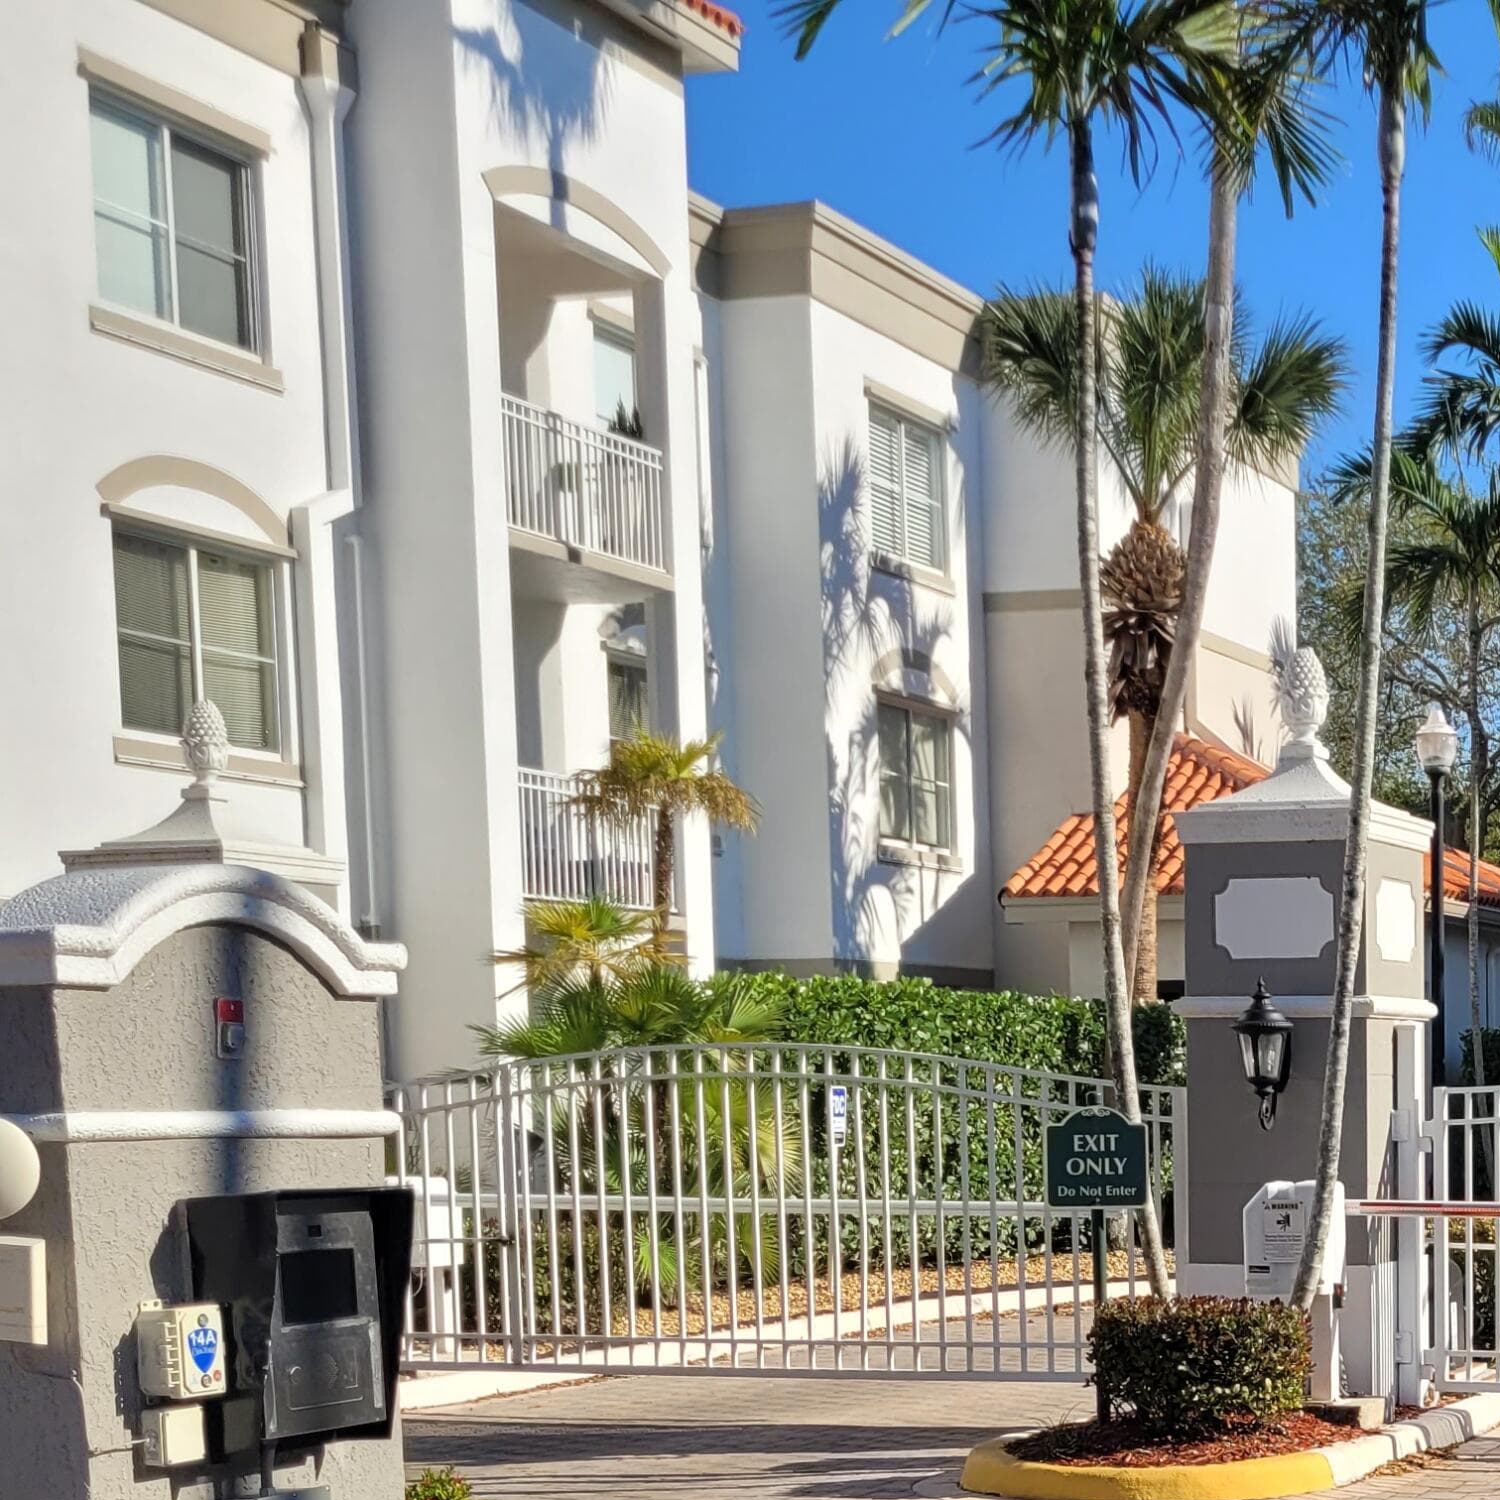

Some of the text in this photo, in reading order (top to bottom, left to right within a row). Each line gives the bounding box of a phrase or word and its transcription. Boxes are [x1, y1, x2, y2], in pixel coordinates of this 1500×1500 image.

[1073, 1134, 1119, 1152] EXIT
[1066, 1157, 1127, 1176] ONLY
[1057, 1184, 1137, 1197] Do Not Enter
[190, 1330, 216, 1347] 14A
